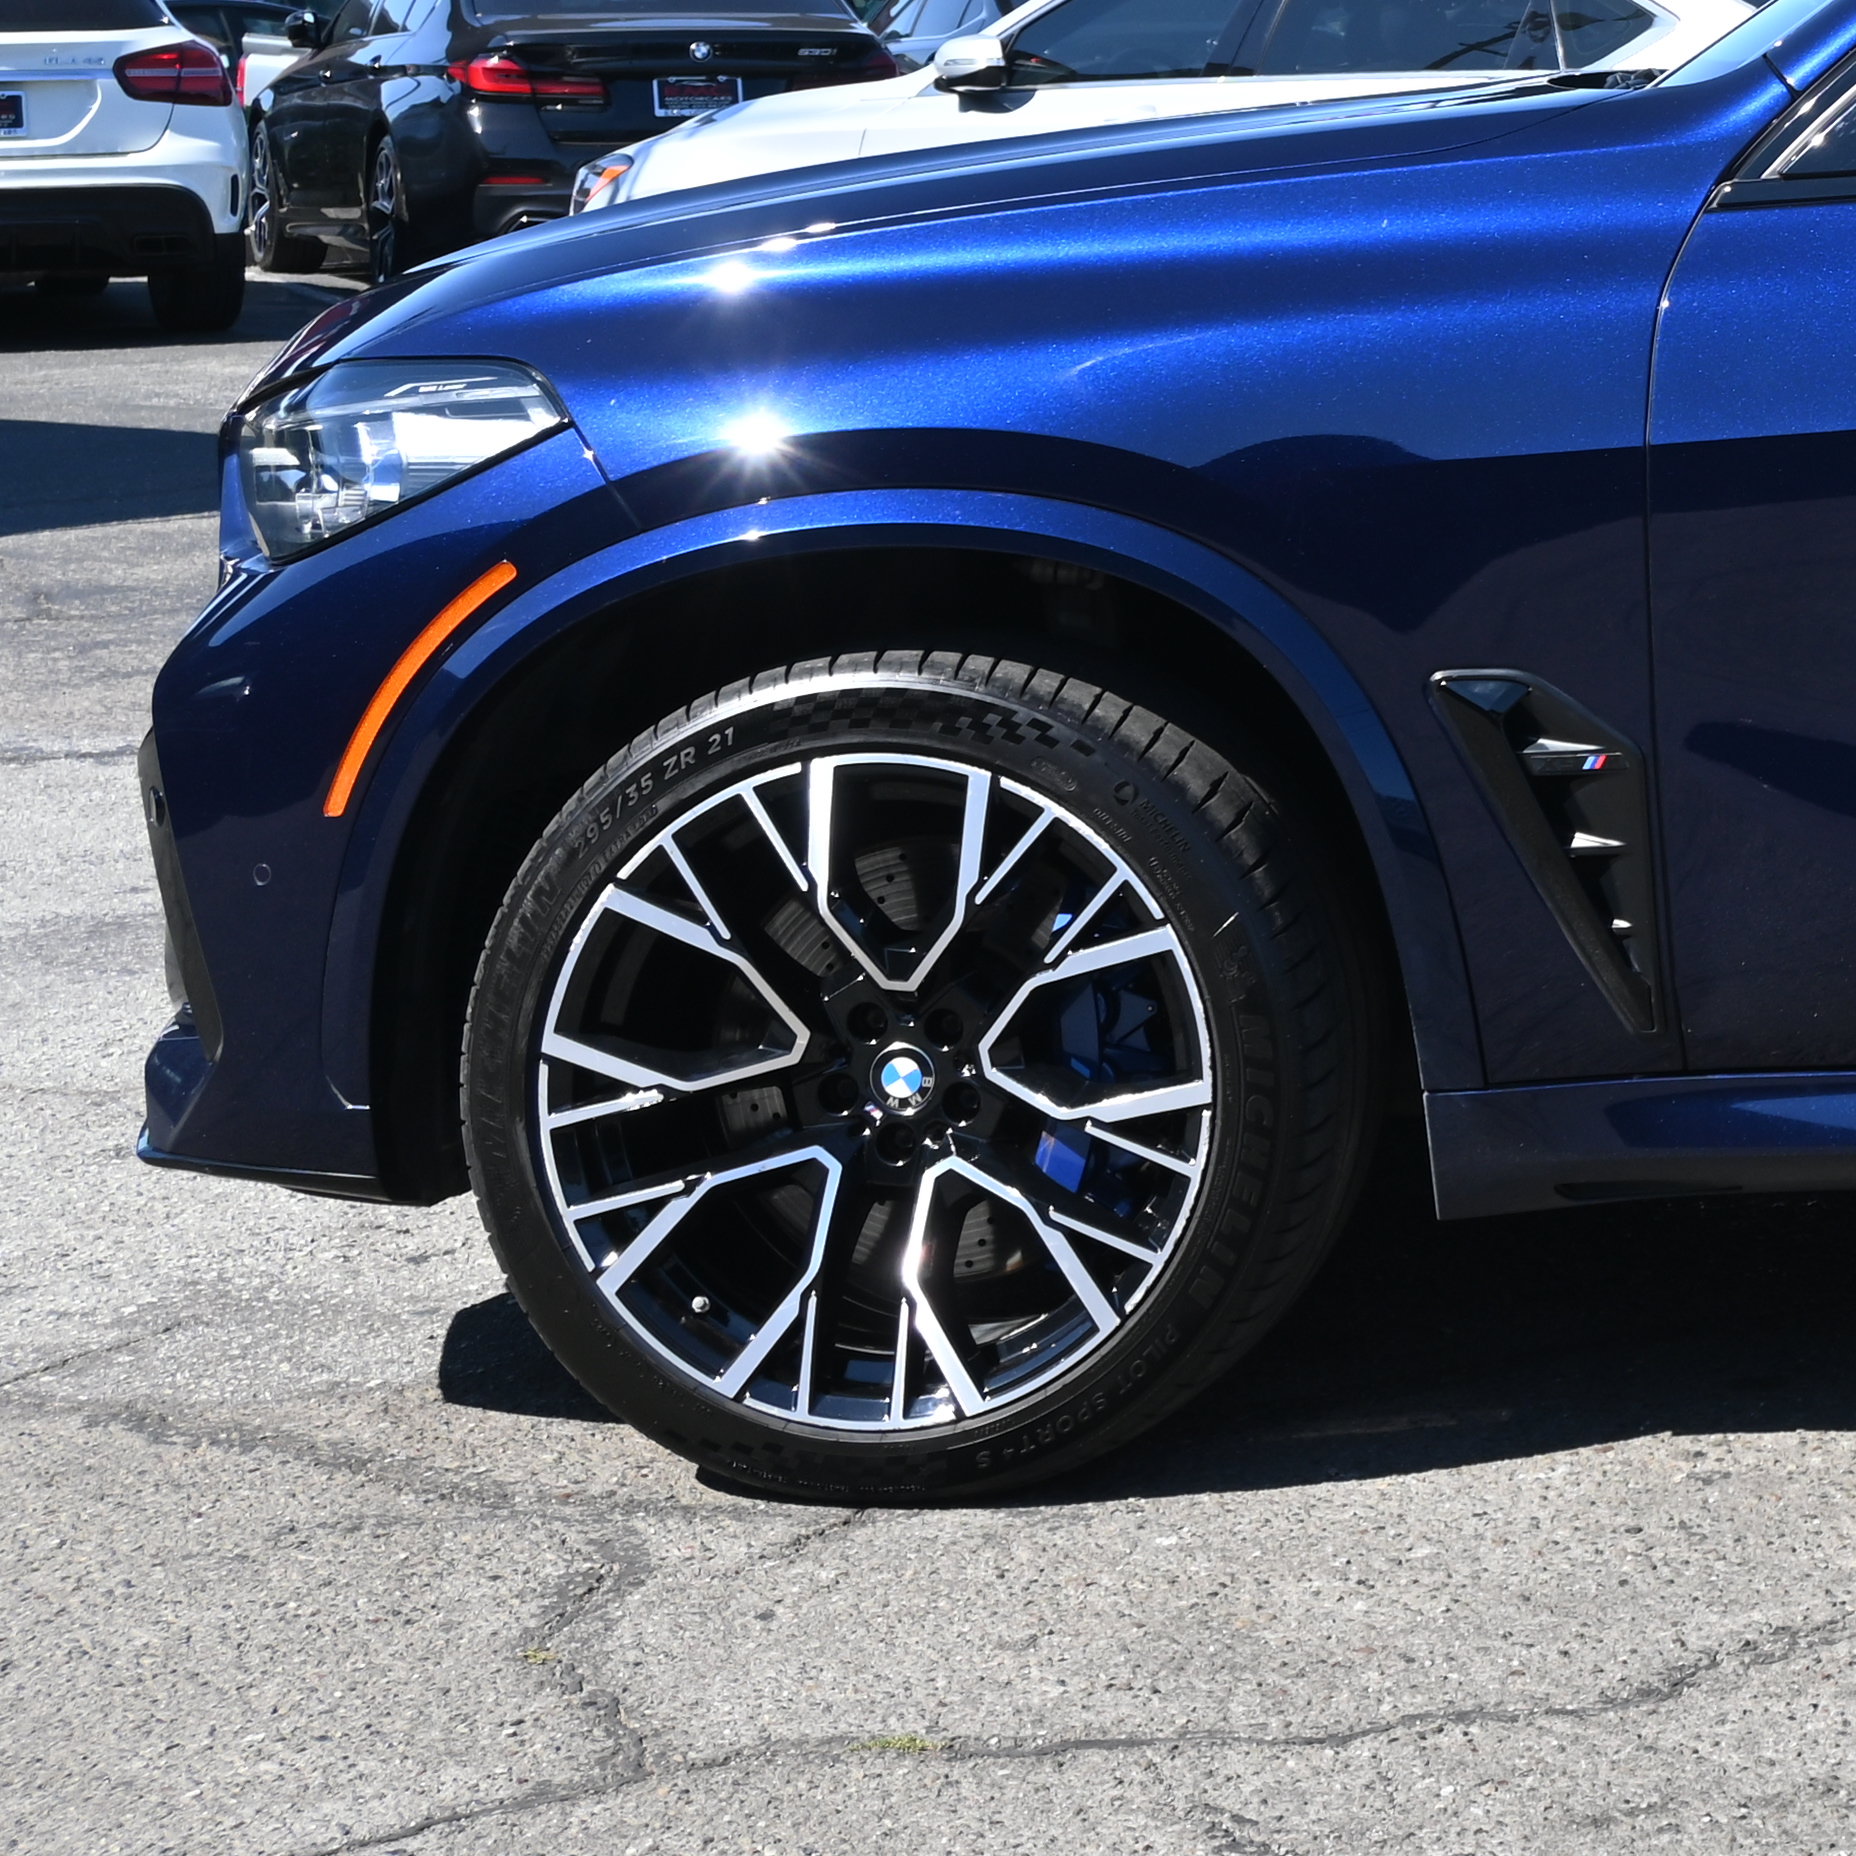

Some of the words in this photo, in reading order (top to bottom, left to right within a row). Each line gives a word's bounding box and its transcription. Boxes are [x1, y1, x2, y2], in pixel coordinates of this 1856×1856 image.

[566, 769, 662, 862] 295/35
[655, 742, 703, 782] ZR
[700, 724, 740, 756] 21
[1184, 1008, 1275, 1311] MICHELIN
